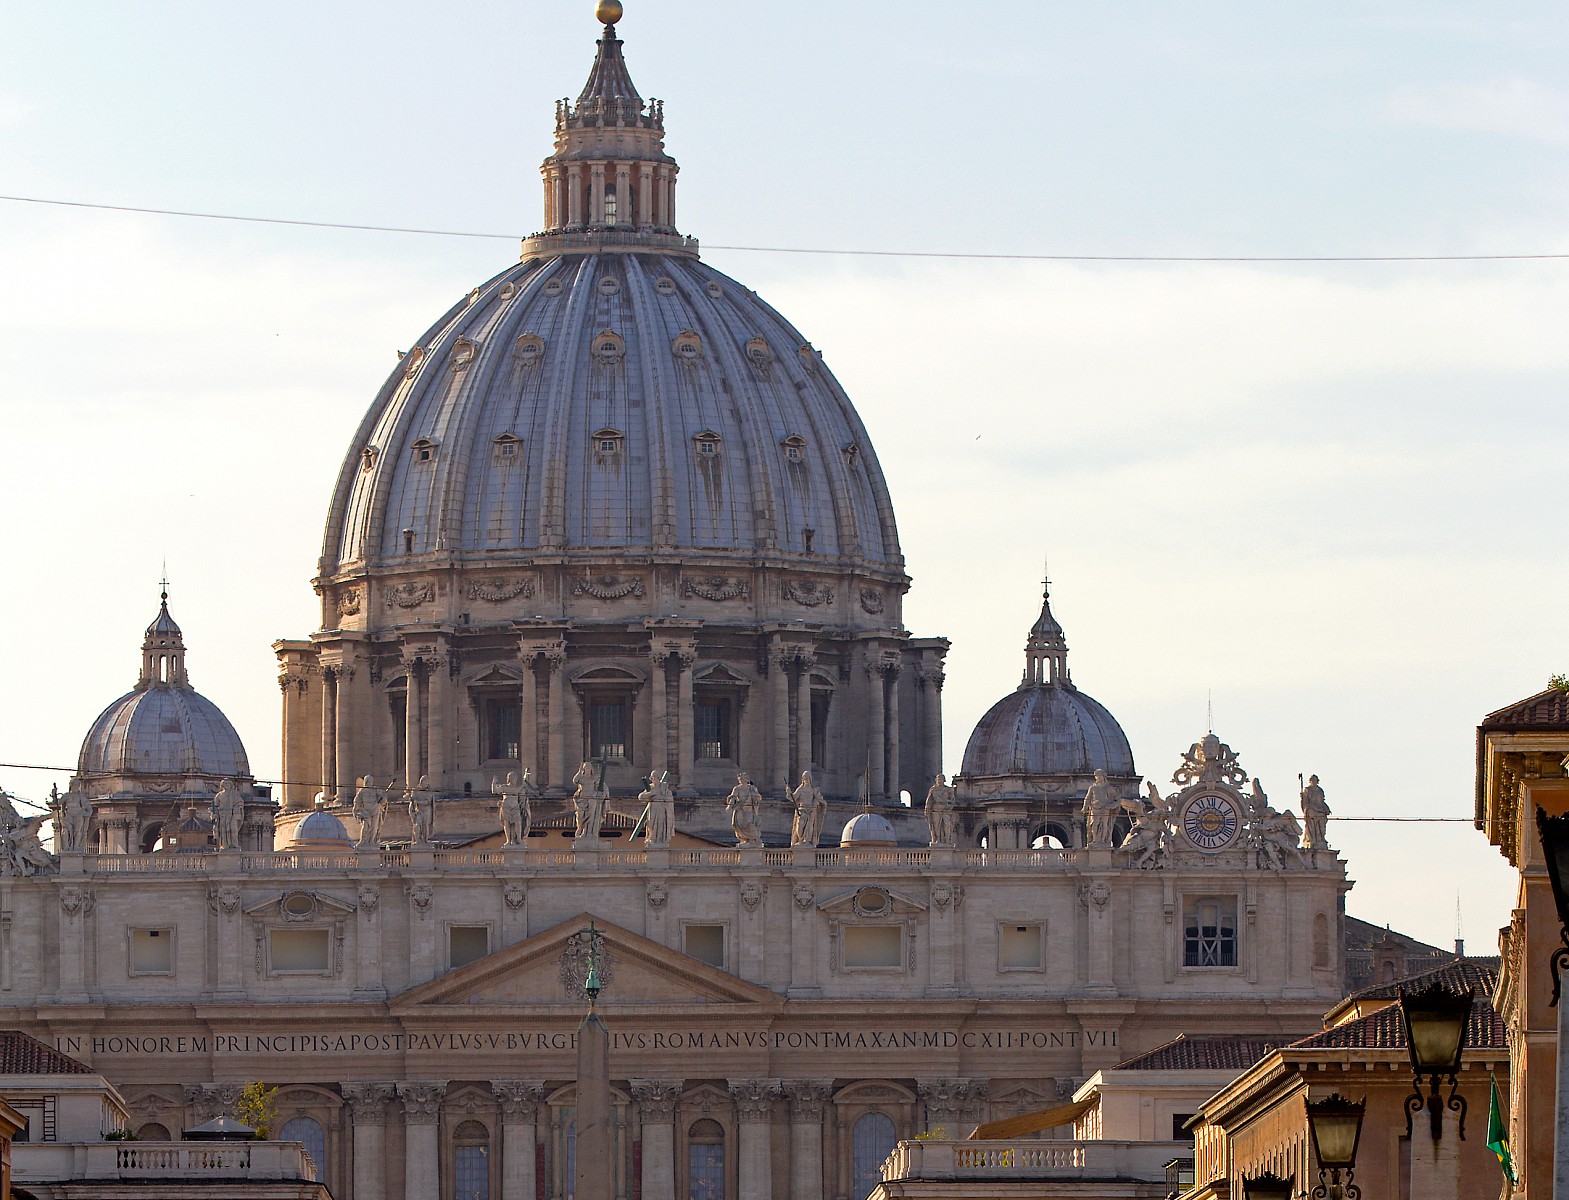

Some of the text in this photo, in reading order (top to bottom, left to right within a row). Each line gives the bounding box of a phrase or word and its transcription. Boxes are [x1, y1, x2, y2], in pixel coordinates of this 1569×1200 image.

[56, 1037, 81, 1053] IN
[93, 1037, 207, 1053] HONOREM
[215, 1035, 329, 1052] PRINCIPIS
[334, 1034, 403, 1051] APOST
[408, 1034, 482, 1050] PAVLVS
[488, 1033, 501, 1049] V
[653, 1032, 768, 1049] ROMANVS
[774, 1032, 833, 1048] PONT
[834, 1032, 884, 1048] MAX
[887, 1032, 917, 1048] AN
[923, 1031, 1012, 1048] MDCXII
[1019, 1031, 1079, 1048] PONT
[1086, 1031, 1119, 1047] VII
